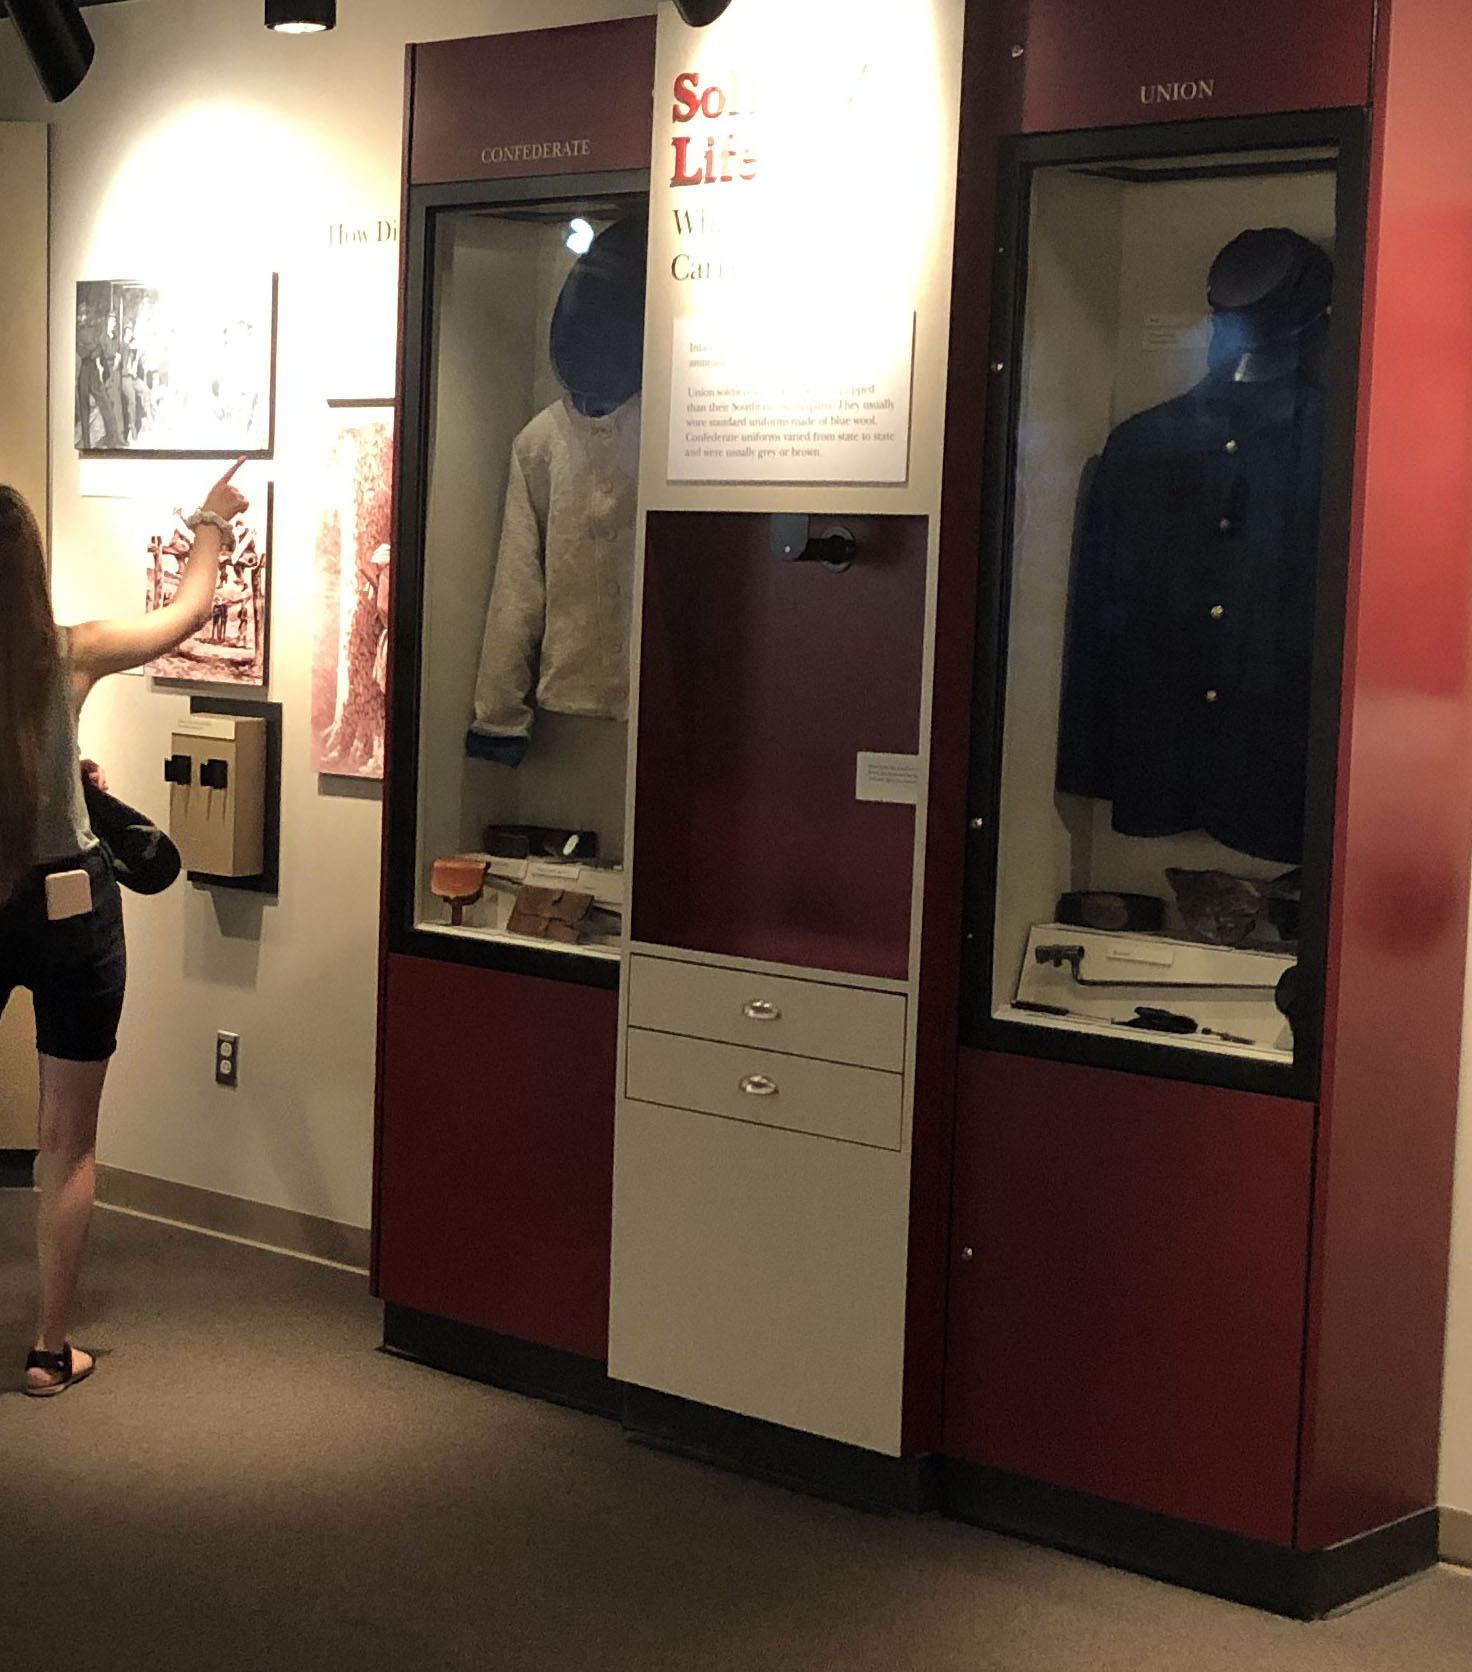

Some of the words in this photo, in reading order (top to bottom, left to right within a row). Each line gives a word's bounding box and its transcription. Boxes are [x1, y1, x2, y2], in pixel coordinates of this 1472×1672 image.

[1140, 79, 1215, 104] UNION
[481, 139, 591, 164] CONFEDERATE
[863, 398, 895, 412] usually
[709, 417, 747, 427] standard
[830, 416, 851, 425] blue
[685, 432, 740, 442] Confederate
[741, 432, 781, 442] uniforms
[783, 431, 811, 442] varied
[812, 431, 836, 441] from
[837, 432, 859, 441] state
[861, 432, 871, 441] to
[873, 432, 895, 441] state
[684, 447, 702, 457] and
[726, 447, 755, 458] usually
[757, 449, 777, 459] grey
[778, 449, 789, 457] or
